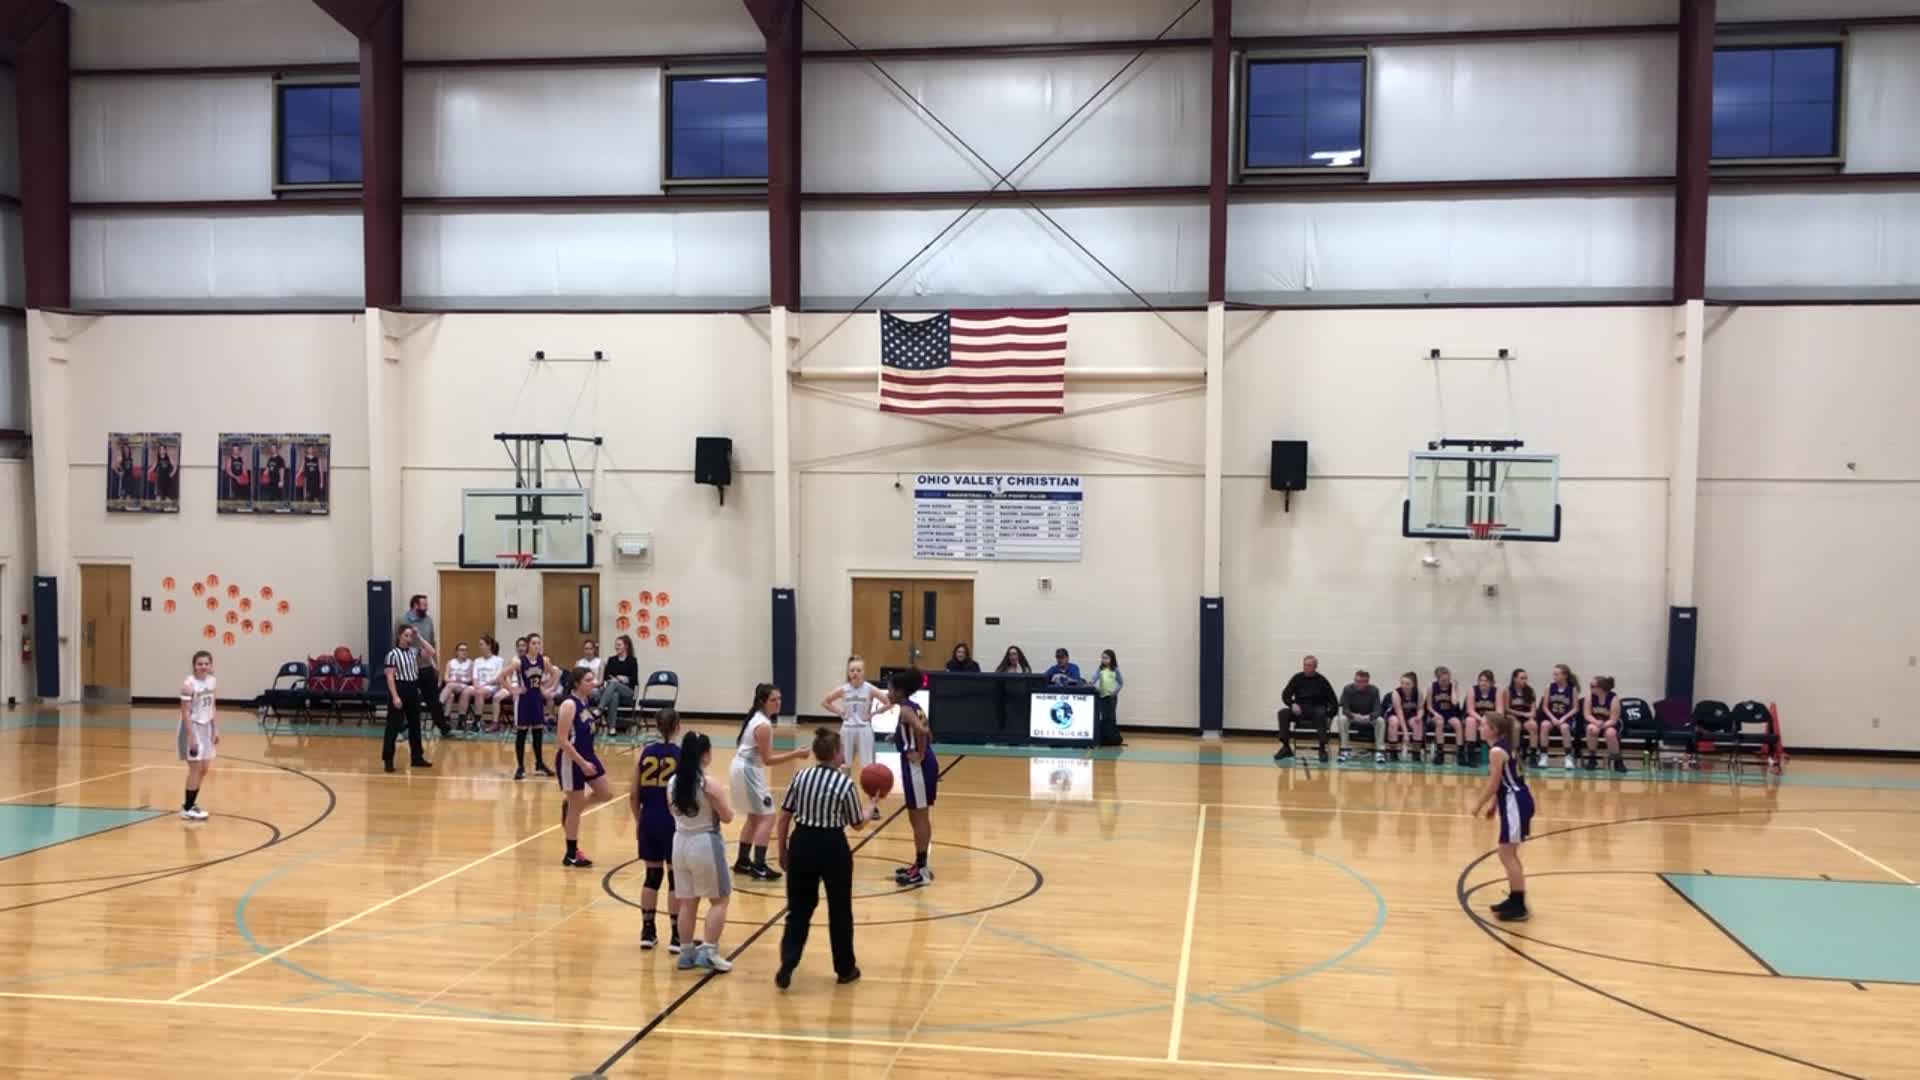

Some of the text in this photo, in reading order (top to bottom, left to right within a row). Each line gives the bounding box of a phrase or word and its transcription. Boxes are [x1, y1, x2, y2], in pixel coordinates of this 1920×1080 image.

[917, 475, 1080, 487] OHIO VALLEY CHRISTIAN
[640, 755, 677, 787] 22
